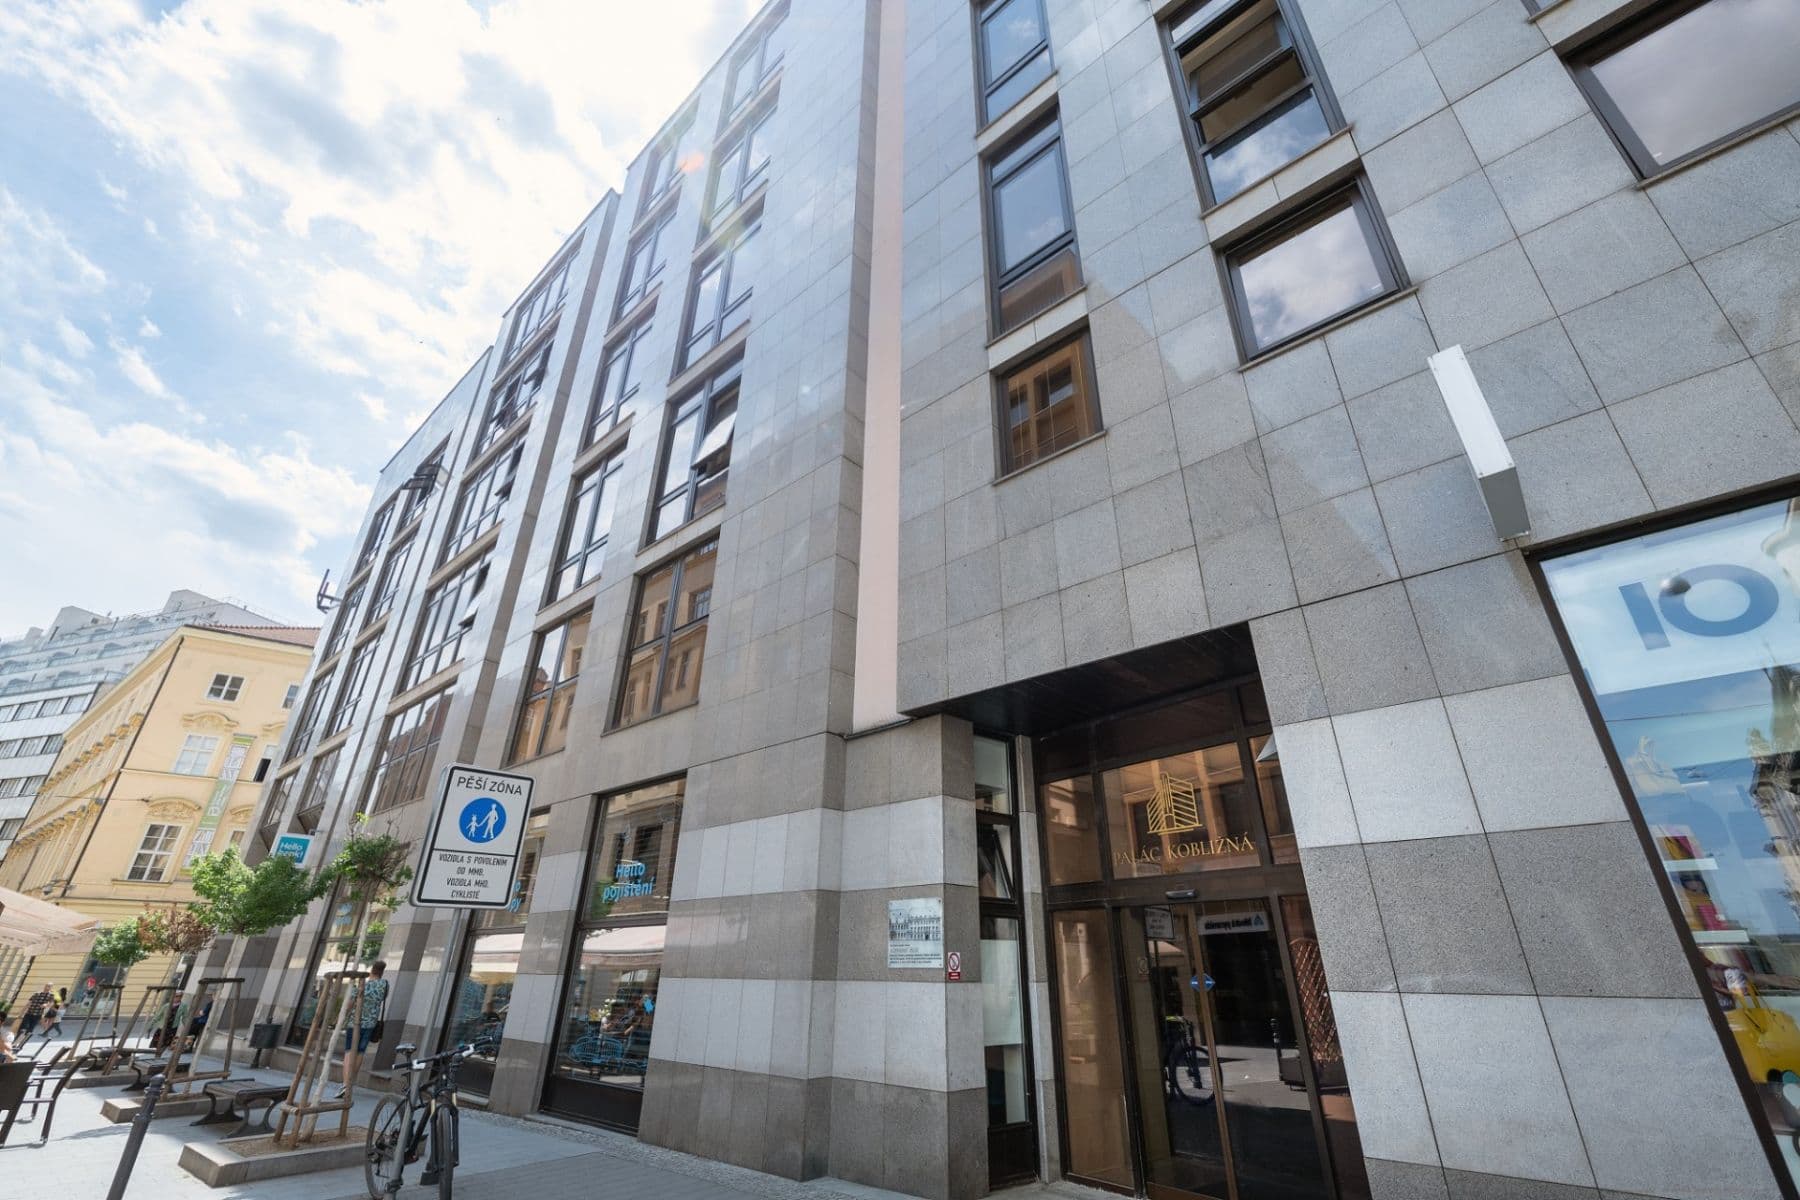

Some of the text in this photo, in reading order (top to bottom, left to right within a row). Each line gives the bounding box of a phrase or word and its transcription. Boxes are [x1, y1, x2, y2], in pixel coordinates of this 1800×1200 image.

[457, 776, 522, 795] PĚŠÍ ZÓNA
[1113, 832, 1255, 865] PALÁC KOBLIŽNÁ
[439, 853, 464, 864] VOZIDLA
[466, 855, 472, 864] S
[456, 866, 466, 875] OD
[615, 862, 646, 877] Hello
[446, 877, 472, 887] VOZIDLA
